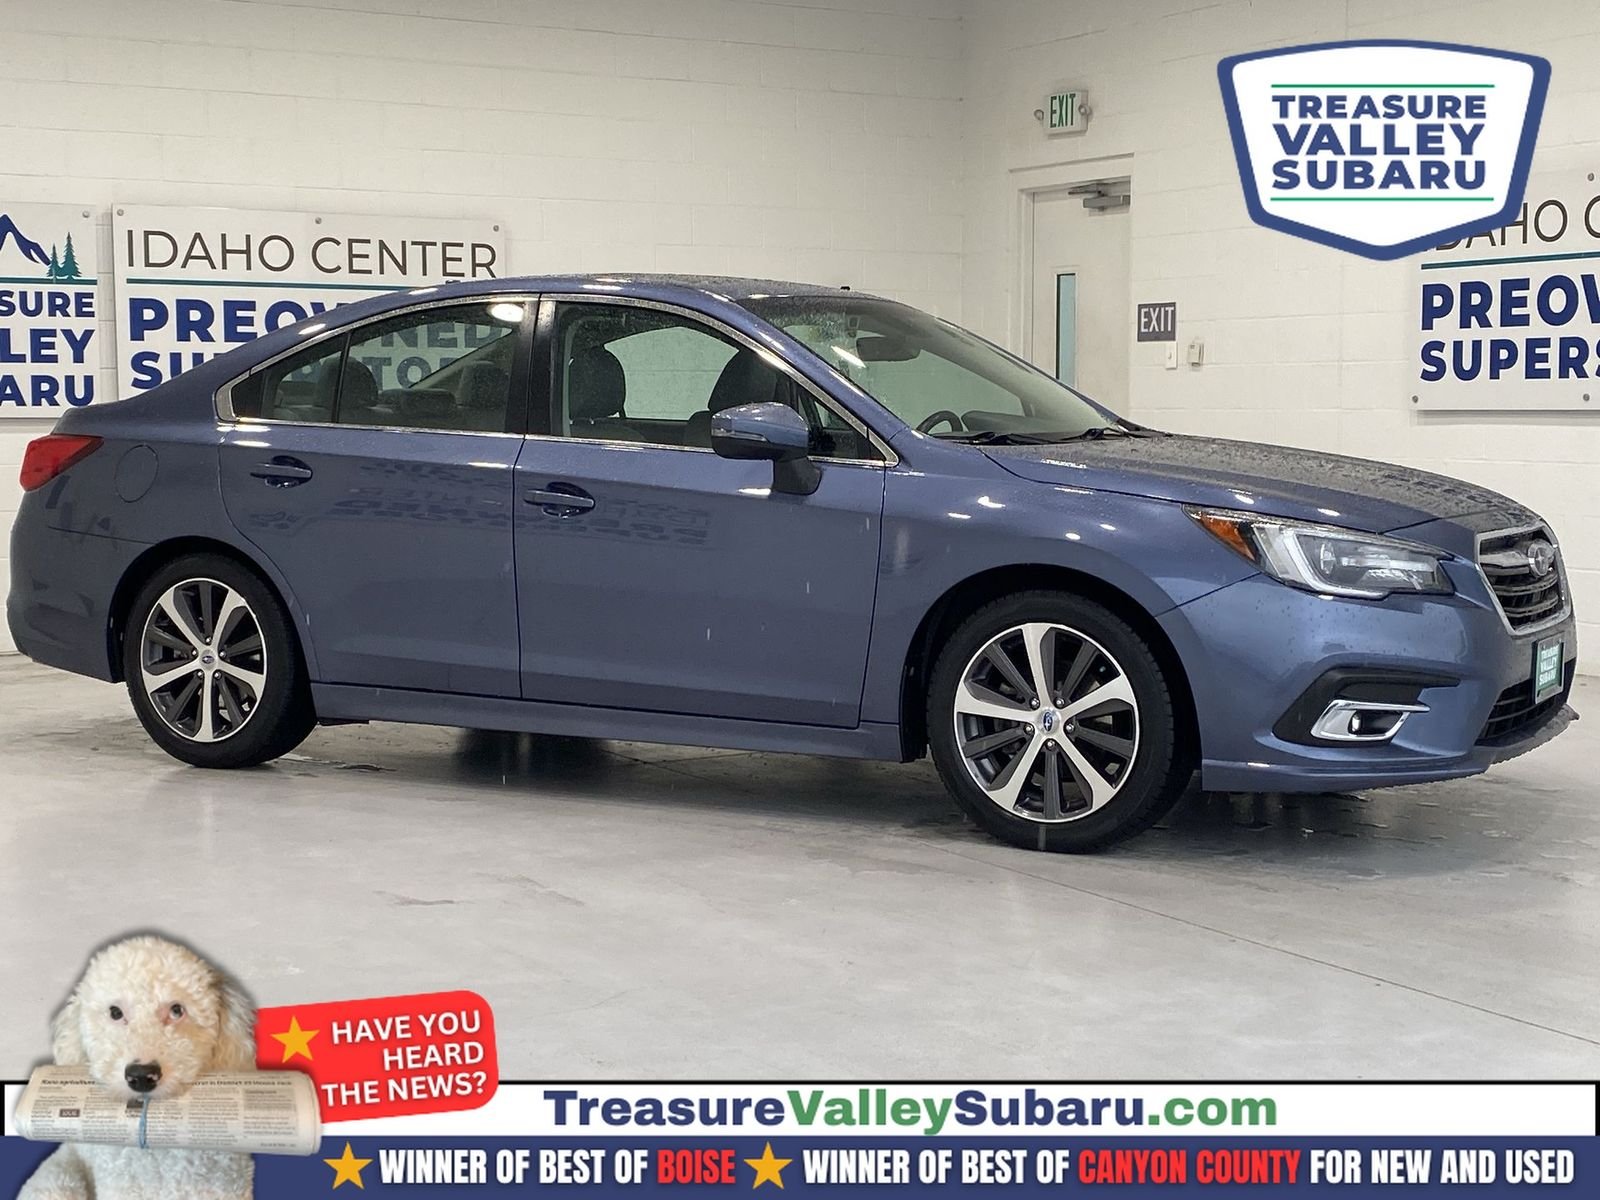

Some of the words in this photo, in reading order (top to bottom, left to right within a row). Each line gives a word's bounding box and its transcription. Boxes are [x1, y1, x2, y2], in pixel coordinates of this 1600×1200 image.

[1050, 93, 1076, 128] EXIT
[126, 229, 294, 272] IDAHO
[311, 236, 498, 279] CENTER
[1140, 306, 1175, 333] EXIT
[1420, 336, 1600, 382] SUPER
